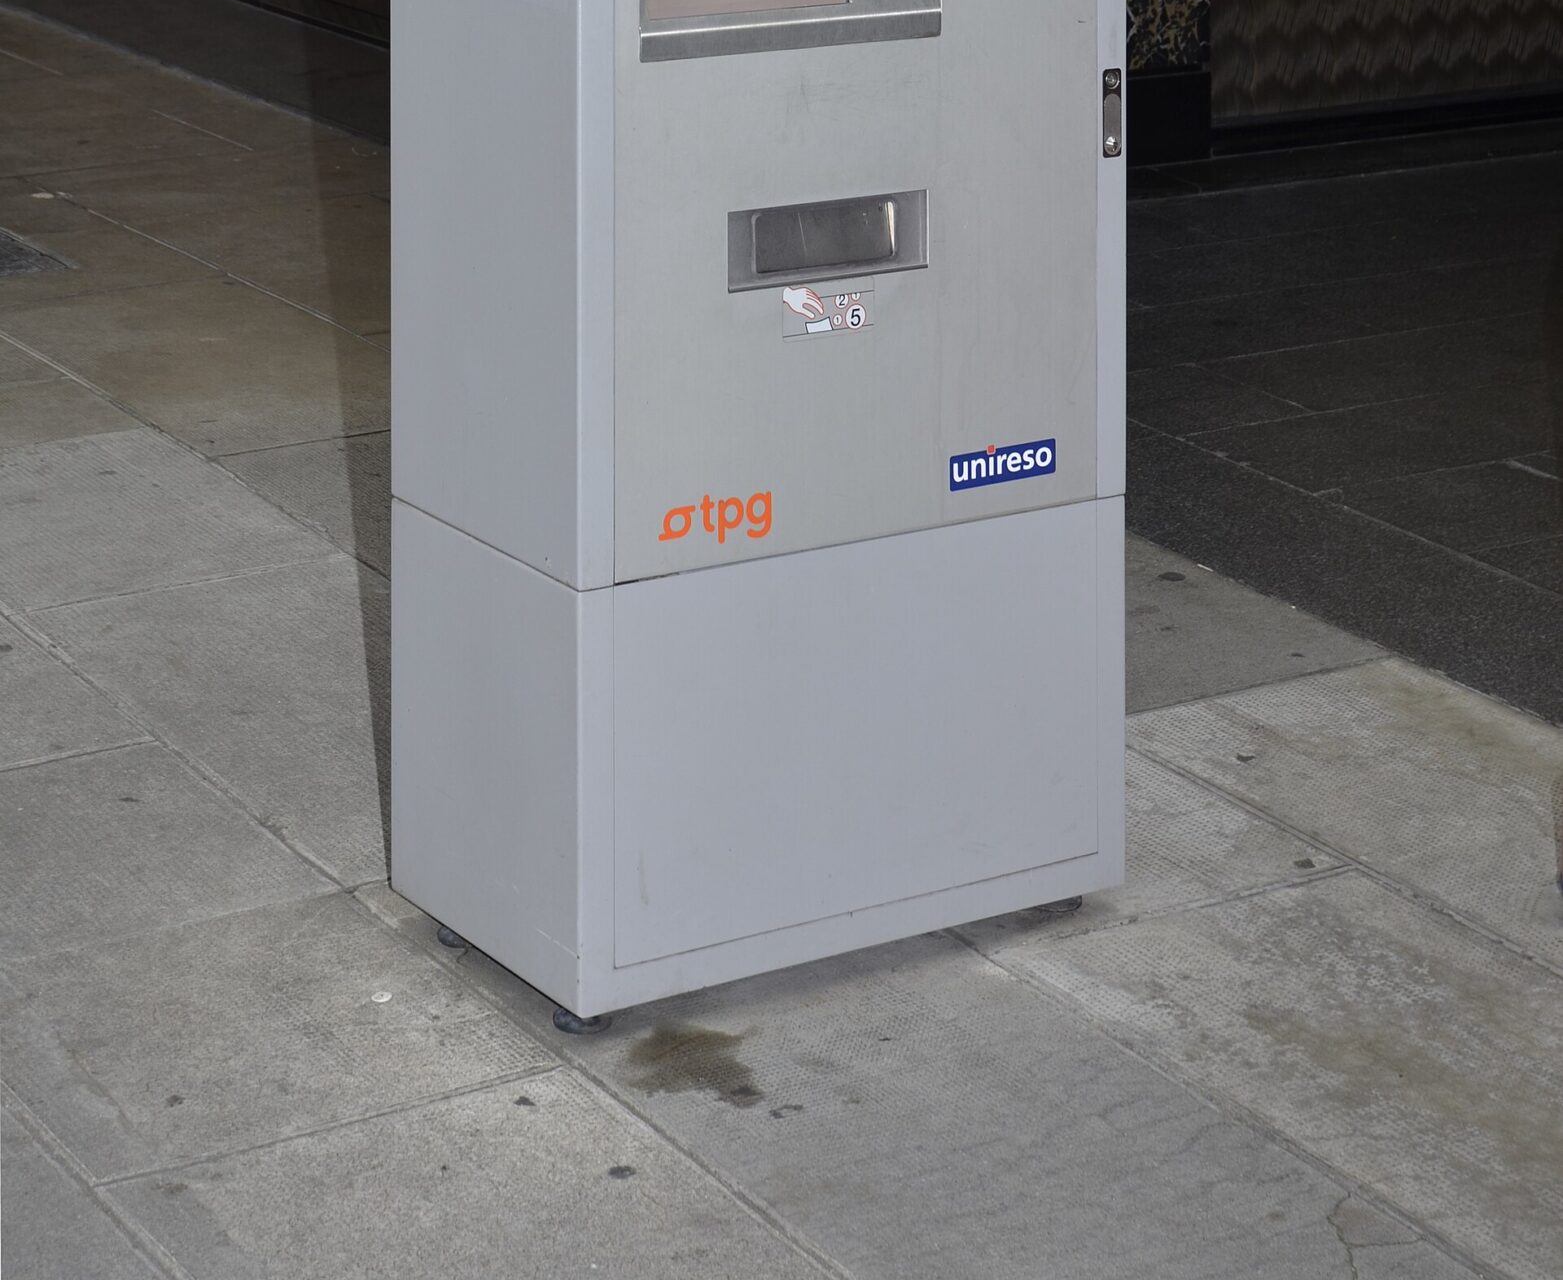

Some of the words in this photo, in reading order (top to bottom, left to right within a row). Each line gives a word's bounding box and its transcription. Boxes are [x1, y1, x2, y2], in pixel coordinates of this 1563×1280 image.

[838, 294, 846, 306] 2
[850, 308, 861, 327] 5
[952, 444, 1053, 483] unireso
